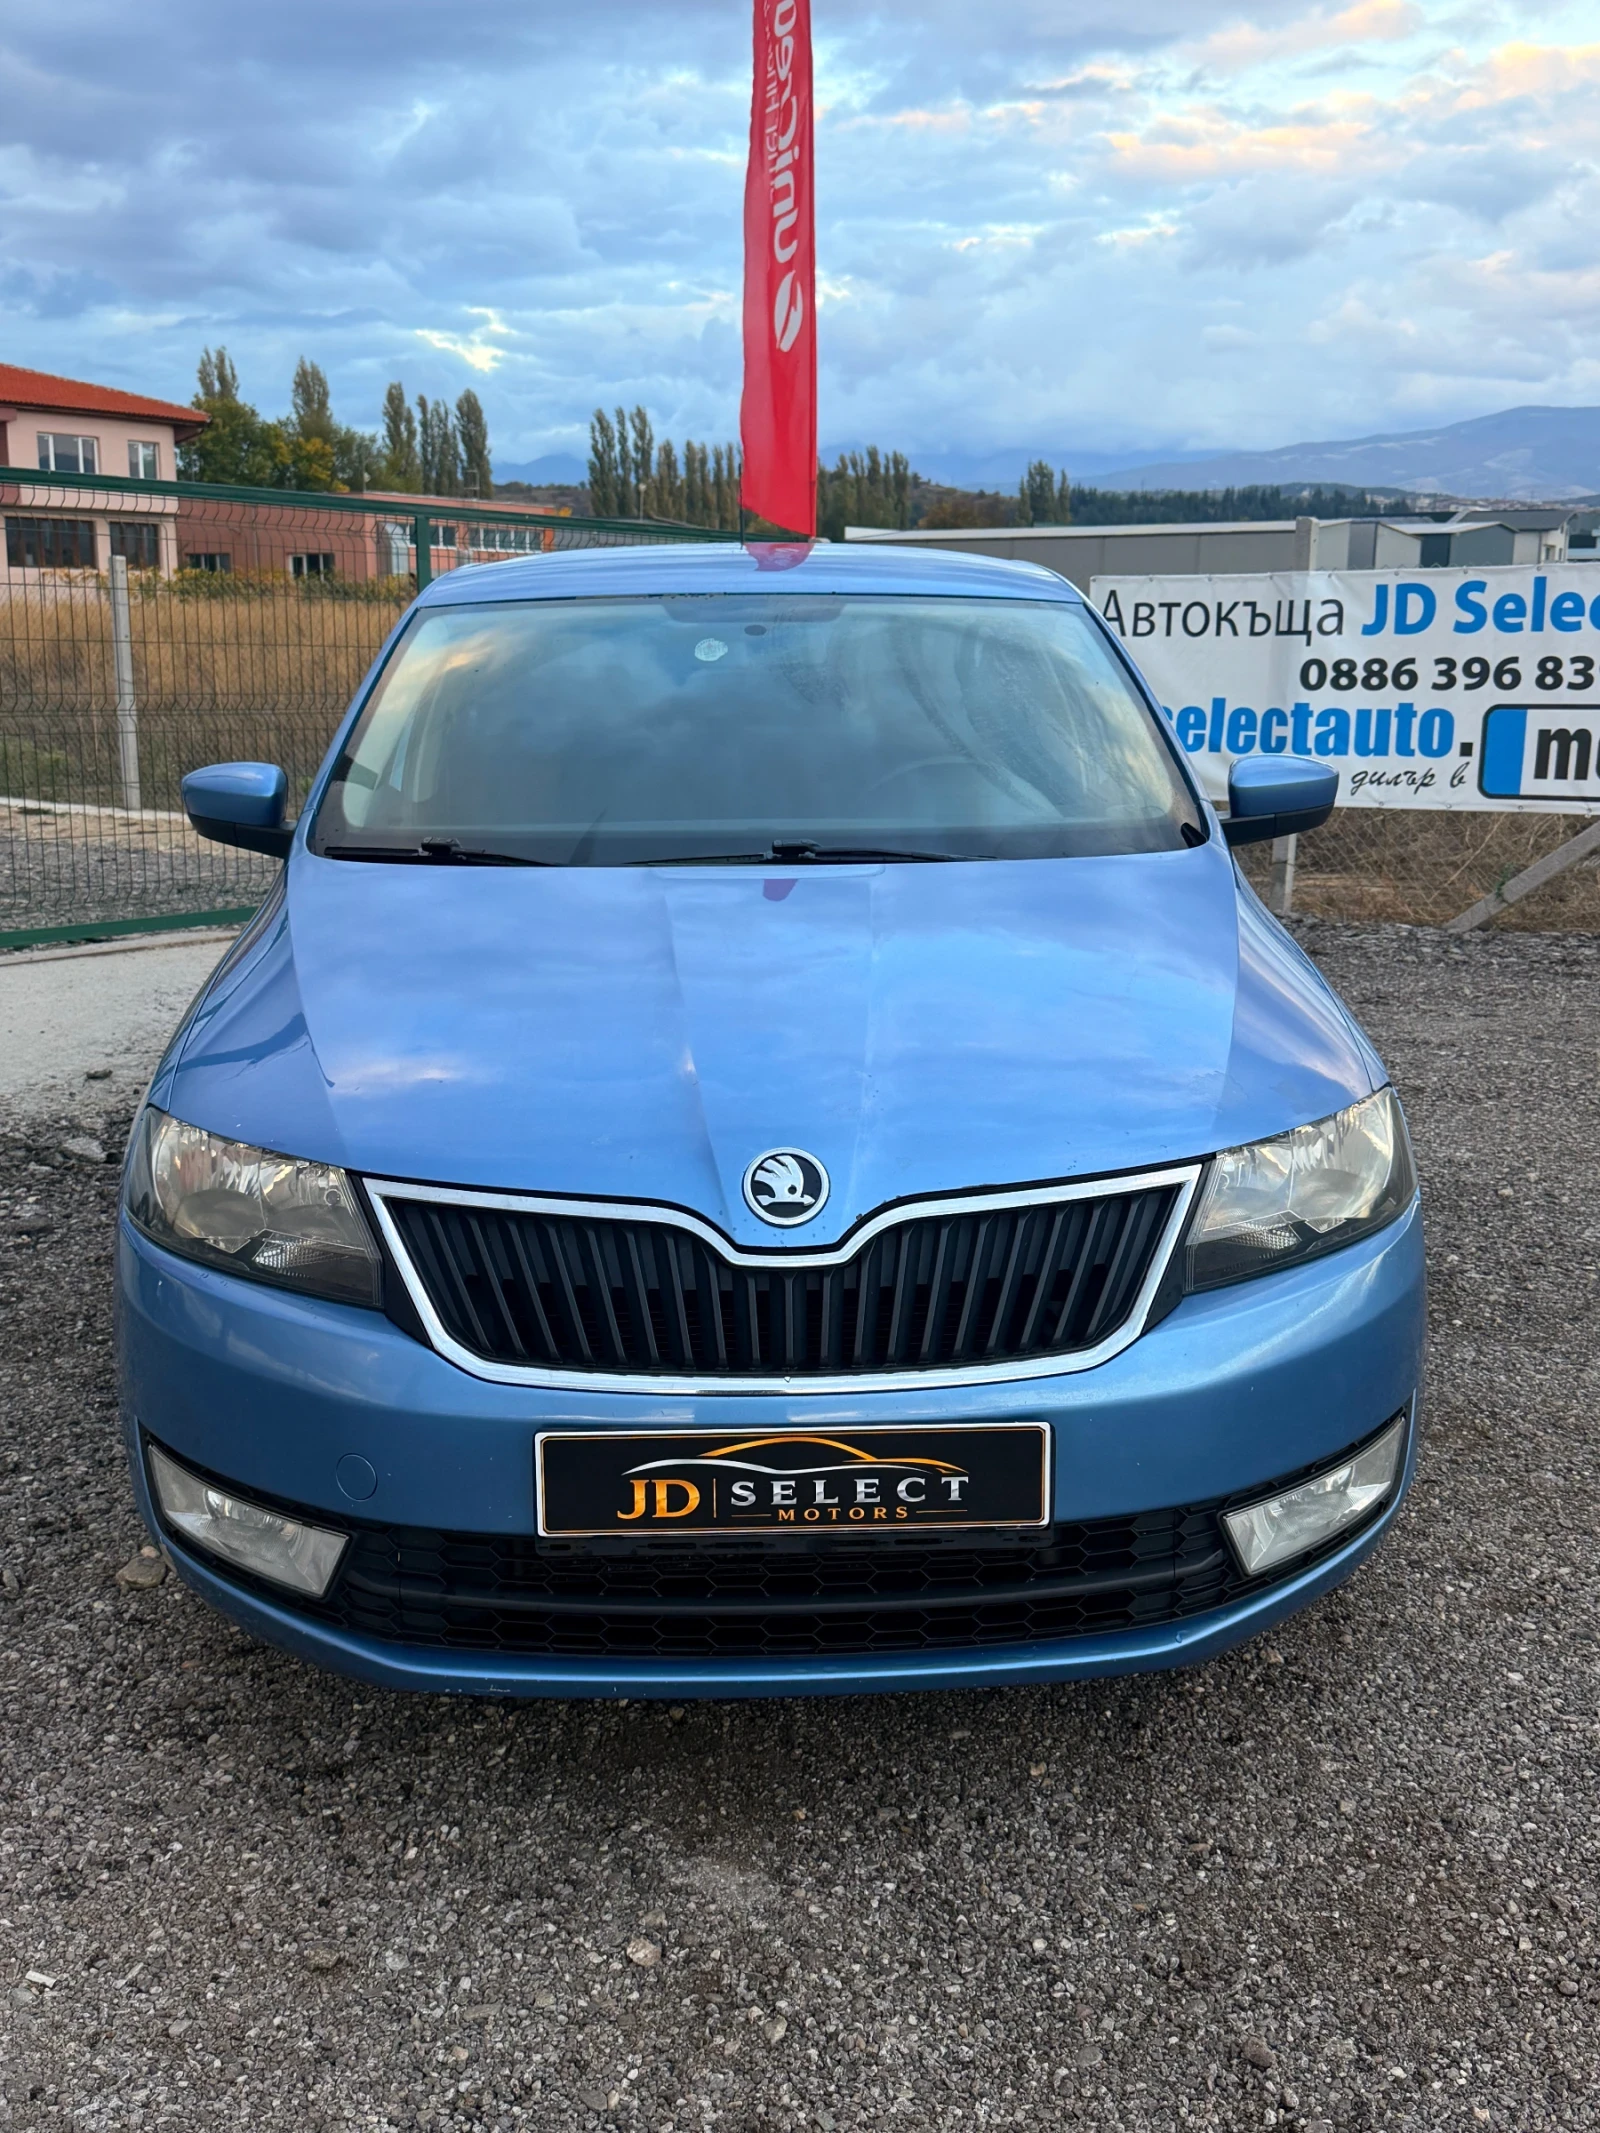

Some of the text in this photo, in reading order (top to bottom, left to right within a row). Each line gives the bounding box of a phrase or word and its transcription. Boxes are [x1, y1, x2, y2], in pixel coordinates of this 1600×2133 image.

[1102, 589, 1345, 647] Автокъща
[1361, 582, 1437, 637] JD
[1299, 655, 1600, 691] 0886 396 83
[1162, 697, 1474, 758] electauto.
[616, 1475, 970, 1520] JD SELECT
[777, 1505, 909, 1522] MOTORS
